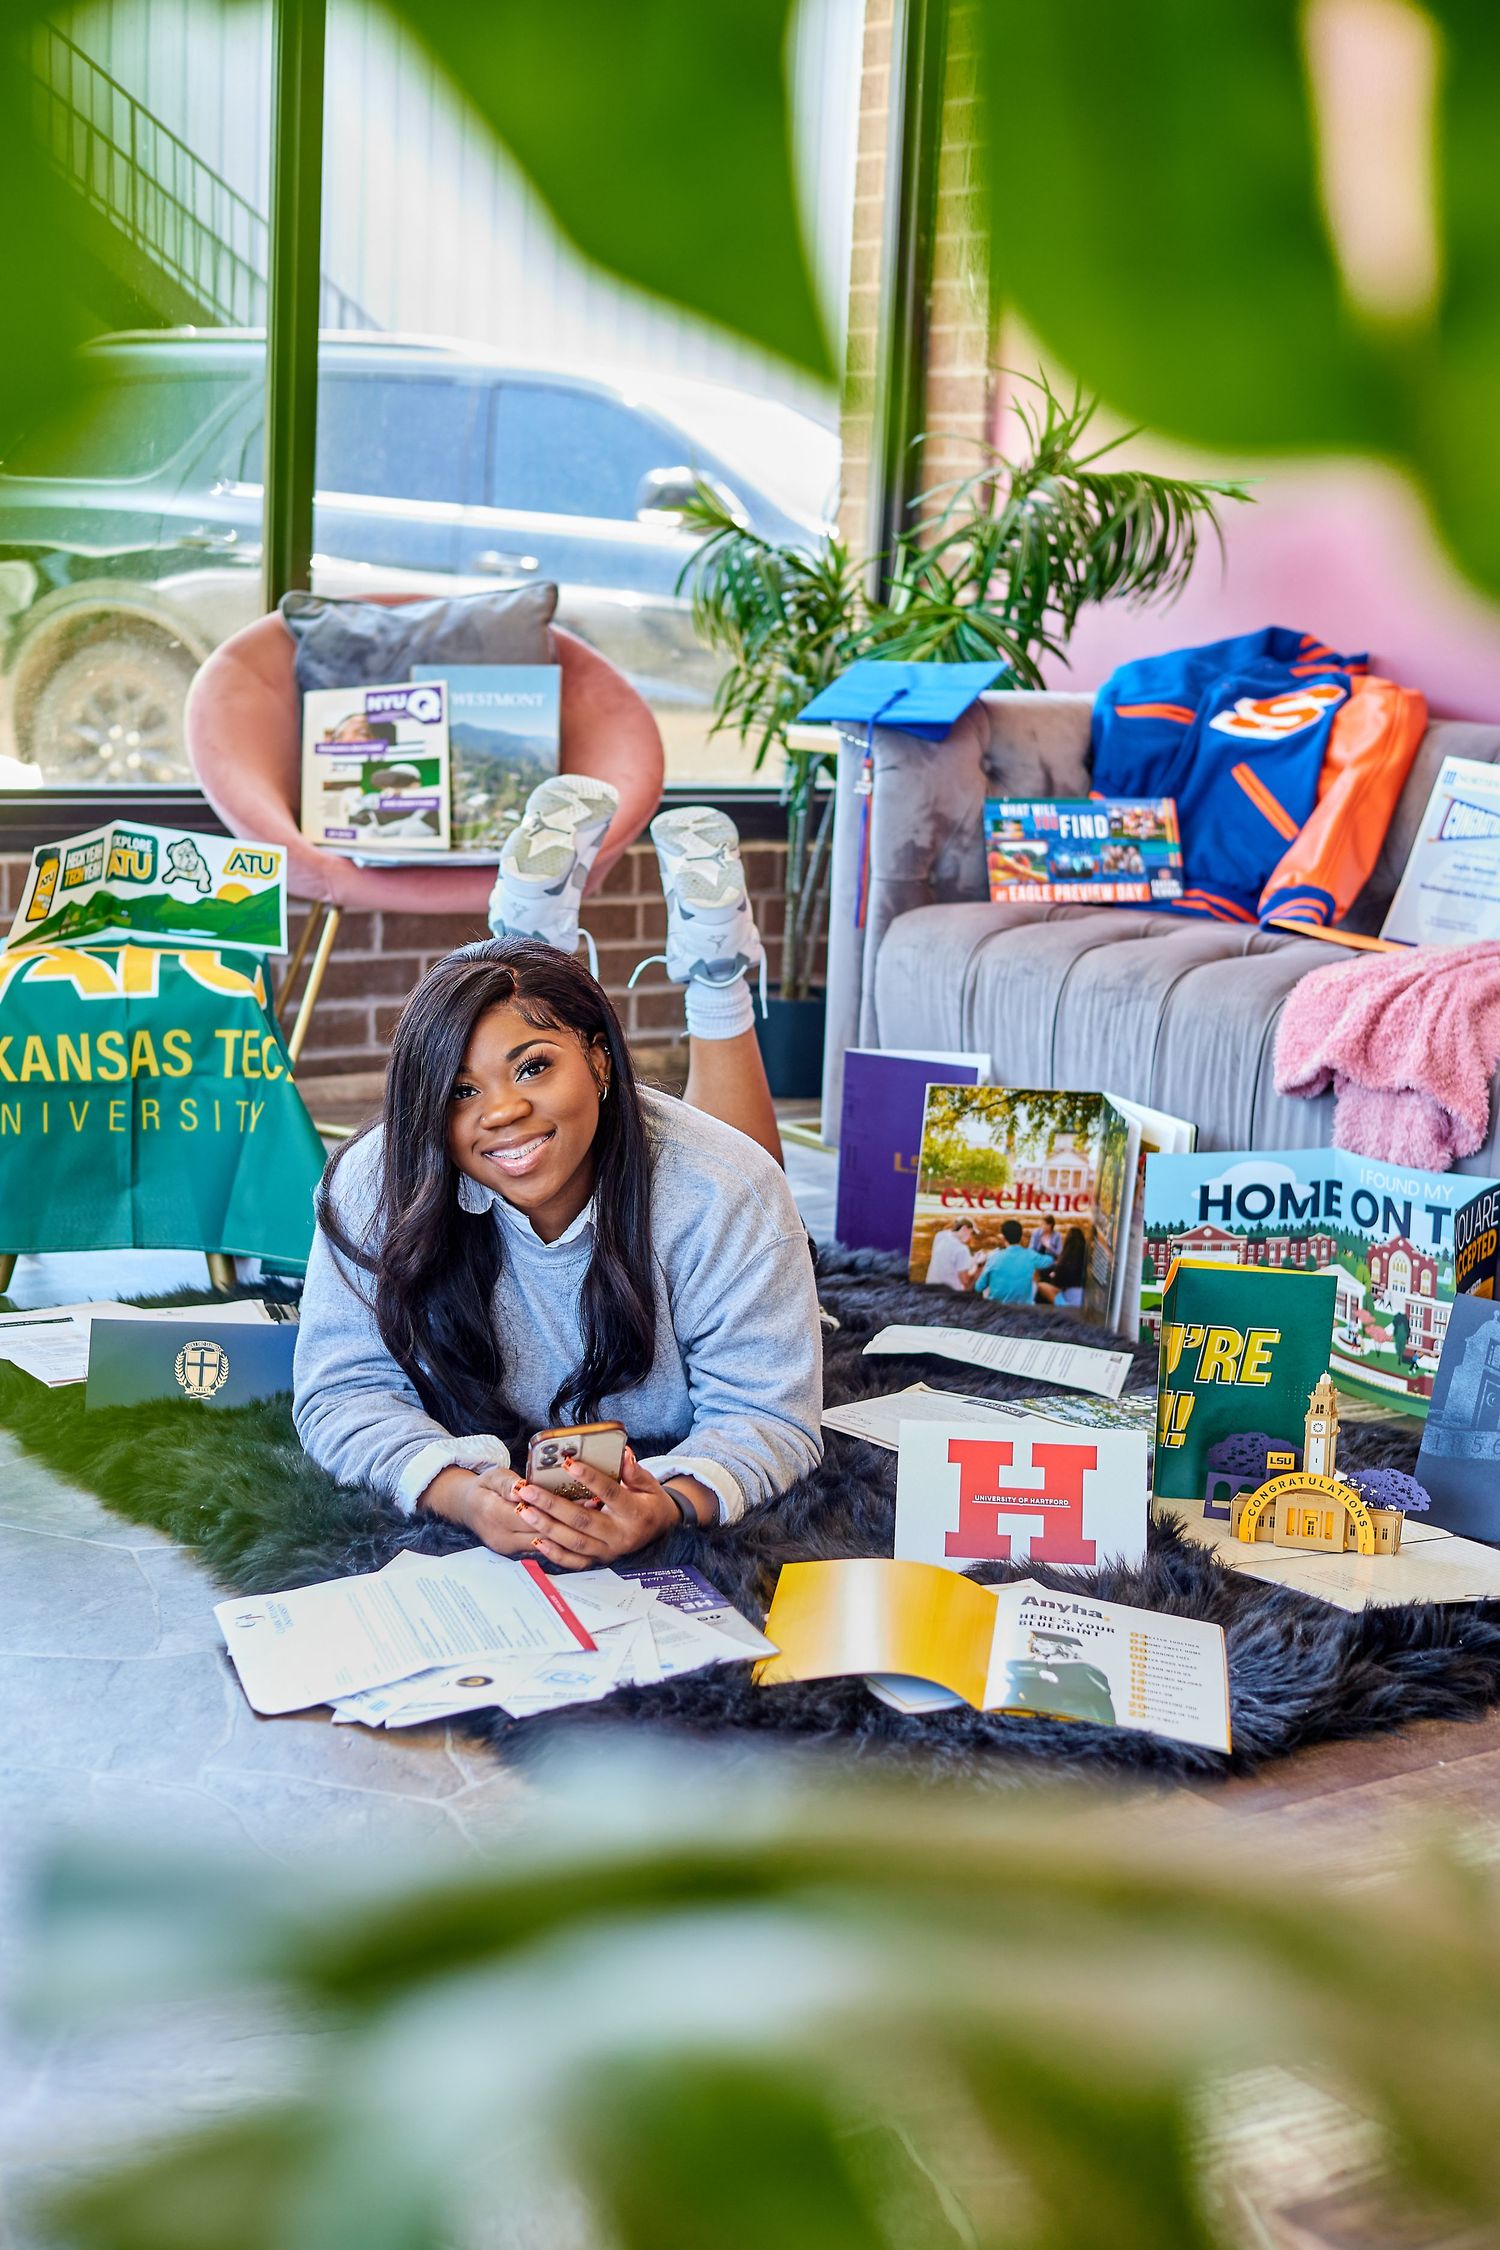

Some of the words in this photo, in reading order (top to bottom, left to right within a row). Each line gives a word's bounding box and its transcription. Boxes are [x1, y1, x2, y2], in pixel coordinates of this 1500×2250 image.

[406, 688, 442, 722] Q
[1000, 804, 1030, 817] WHAT
[1032, 804, 1057, 817] WILL
[1059, 814, 1109, 839] FIND
[113, 834, 153, 853] EXPLORE
[107, 848, 152, 881] ATU
[229, 853, 275, 875] ATU
[1008, 884, 1050, 902] EAGLE
[1054, 884, 1112, 902] PREVIEW
[1116, 883, 1144, 901] DAY
[214, 1029, 295, 1083] TEC
[1367, 1172, 1420, 1197] FOUND
[1424, 1183, 1455, 1202] MY
[1198, 1180, 1343, 1221] HOME
[1350, 1189, 1412, 1239] ON
[1473, 1190, 1500, 1237] ARE
[1269, 1456, 1292, 1465] LSU
[944, 1438, 1098, 1566] H
[974, 1494, 1017, 1504] UNIVERSITY
[1030, 1497, 1069, 1506] HARTFORD
[1247, 1476, 1368, 1528] CONGRATULATIONS
[1018, 1620, 1101, 1637] BLUEPRINT
[1019, 1613, 1071, 1626] HERE'S
[1077, 1621, 1116, 1634] YOUR
